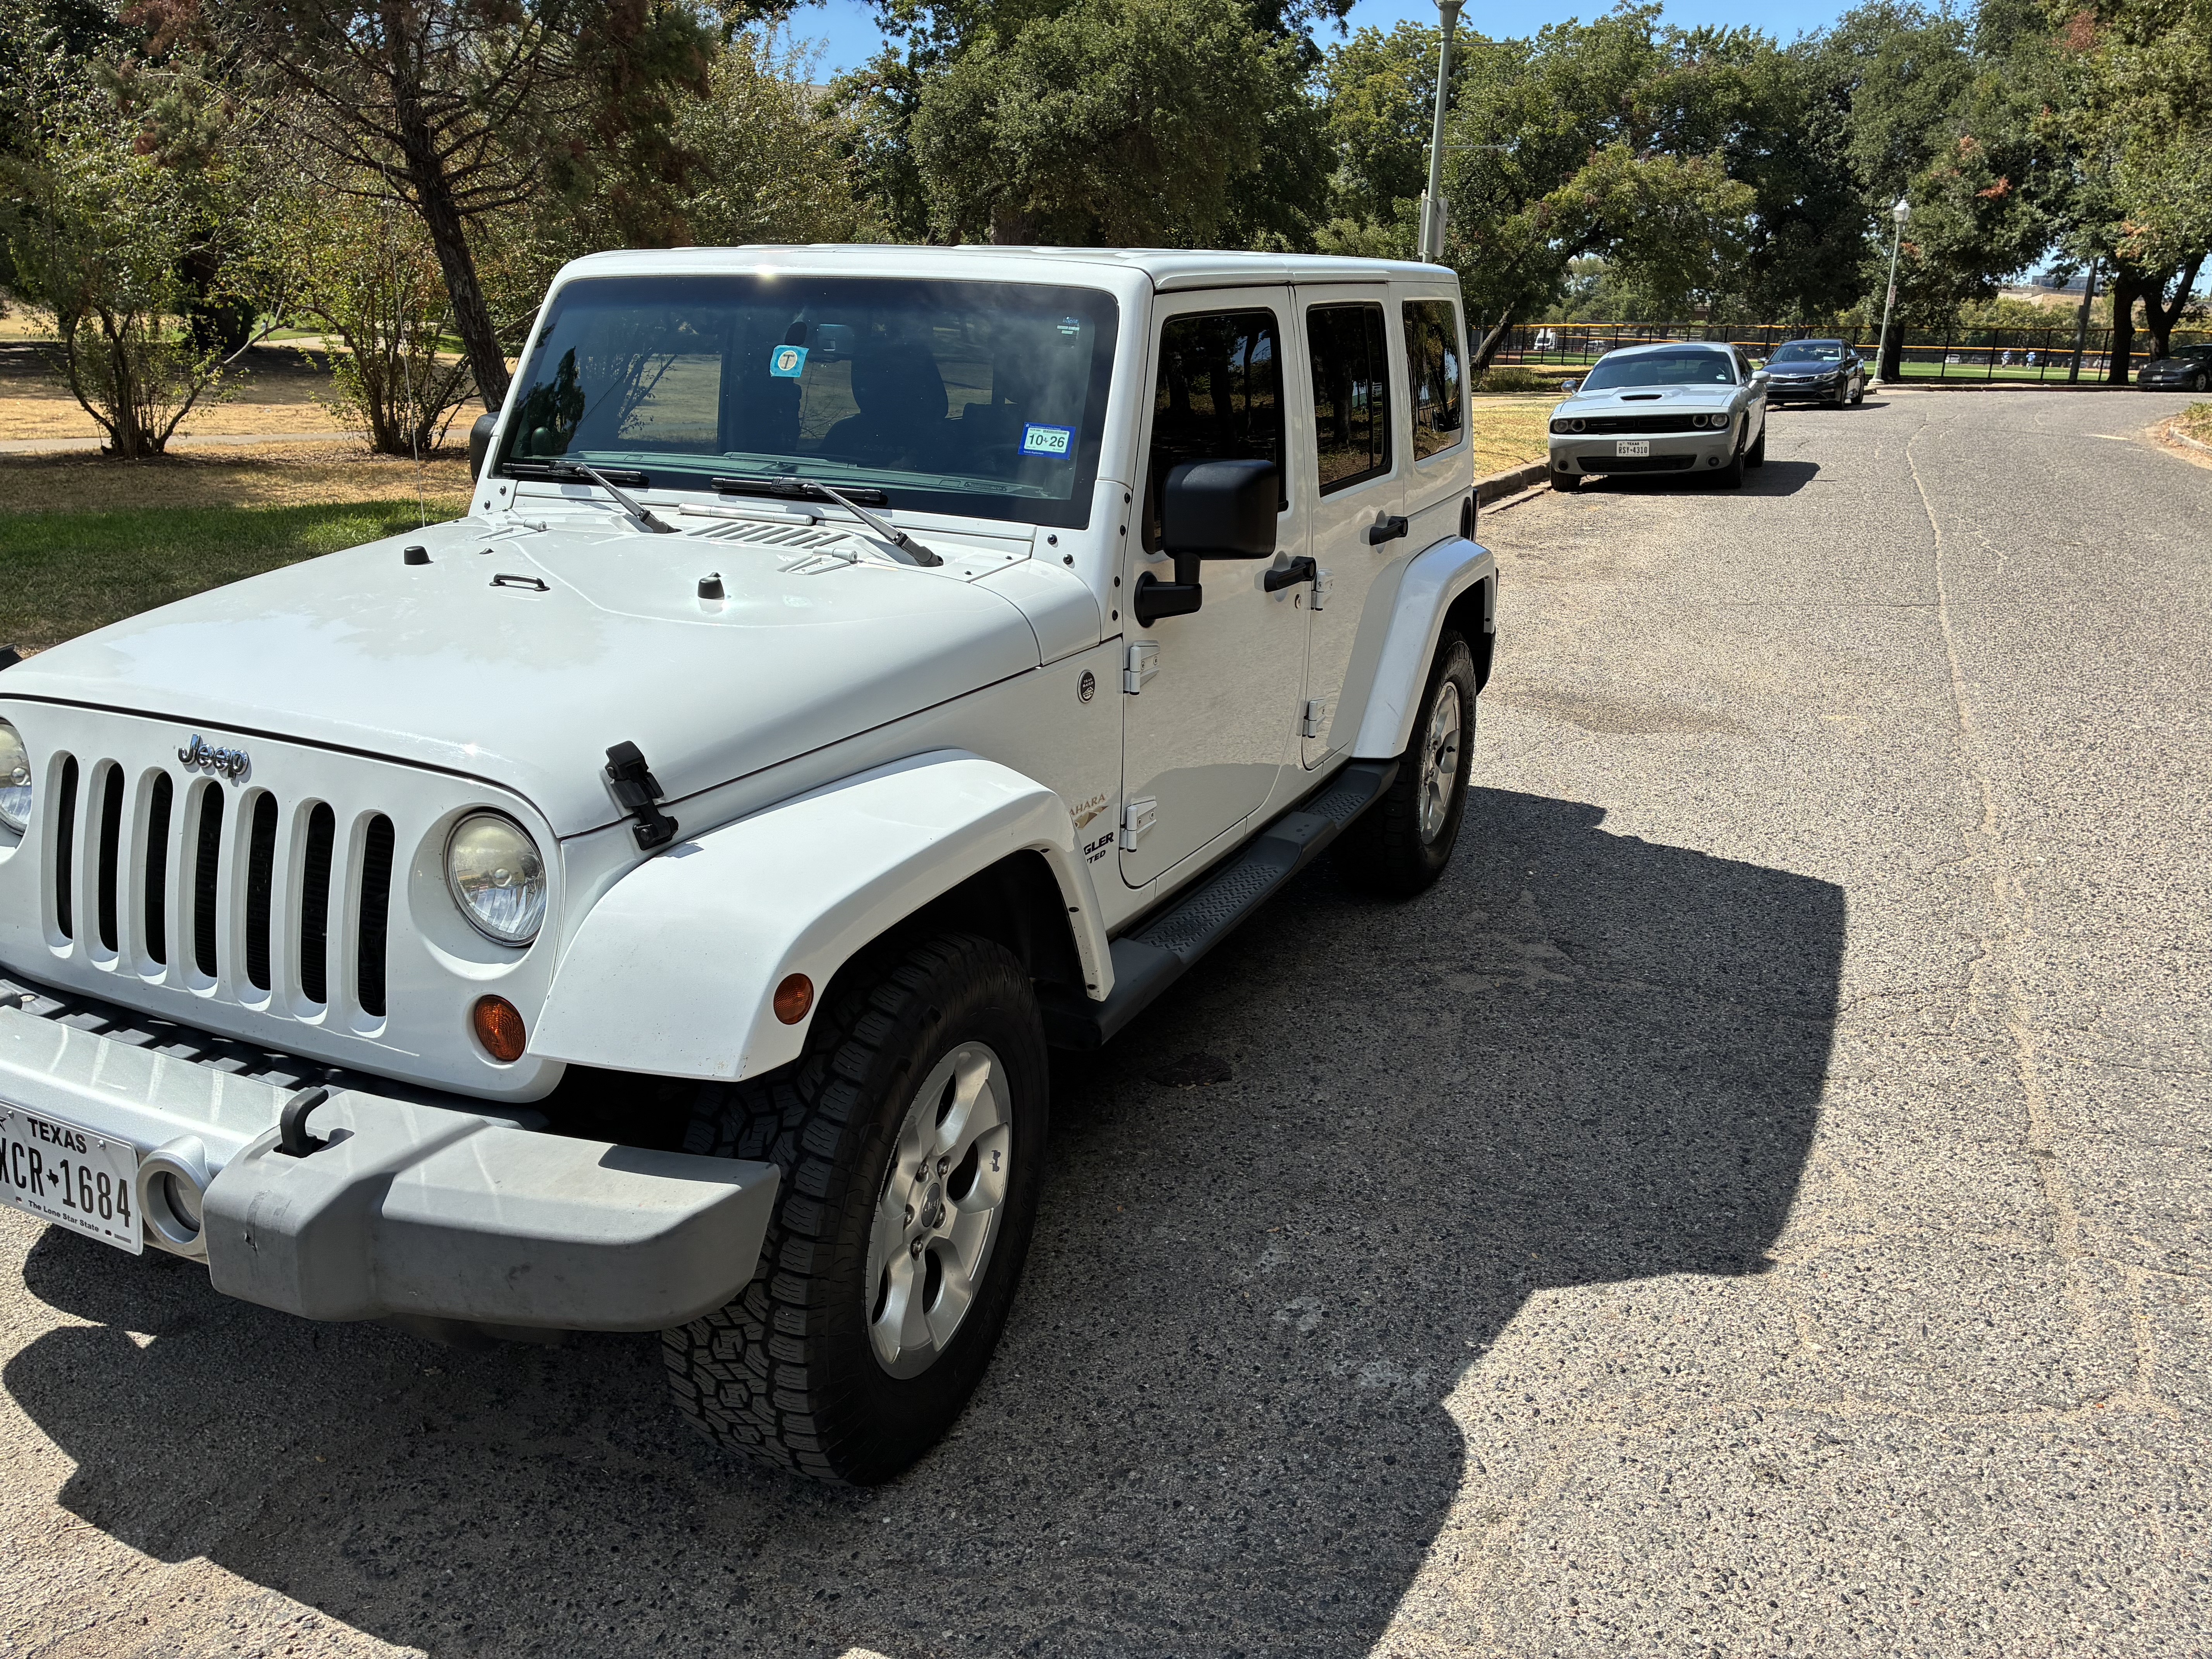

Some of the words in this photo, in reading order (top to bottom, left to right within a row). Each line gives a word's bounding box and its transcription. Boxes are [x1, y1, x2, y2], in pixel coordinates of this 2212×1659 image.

[783, 354, 795, 369] T
[1029, 434, 1043, 446] 10
[1049, 436, 1065, 448] 26
[178, 733, 249, 780] Jeep
[1069, 793, 1105, 816] AHARA
[27, 1117, 87, 1154] TEXAS
[60, 1159, 131, 1228] 1684
[28, 1200, 42, 1211] The
[43, 1205, 61, 1218] Lone
[62, 1212, 78, 1224] Star
[79, 1219, 99, 1232] State
